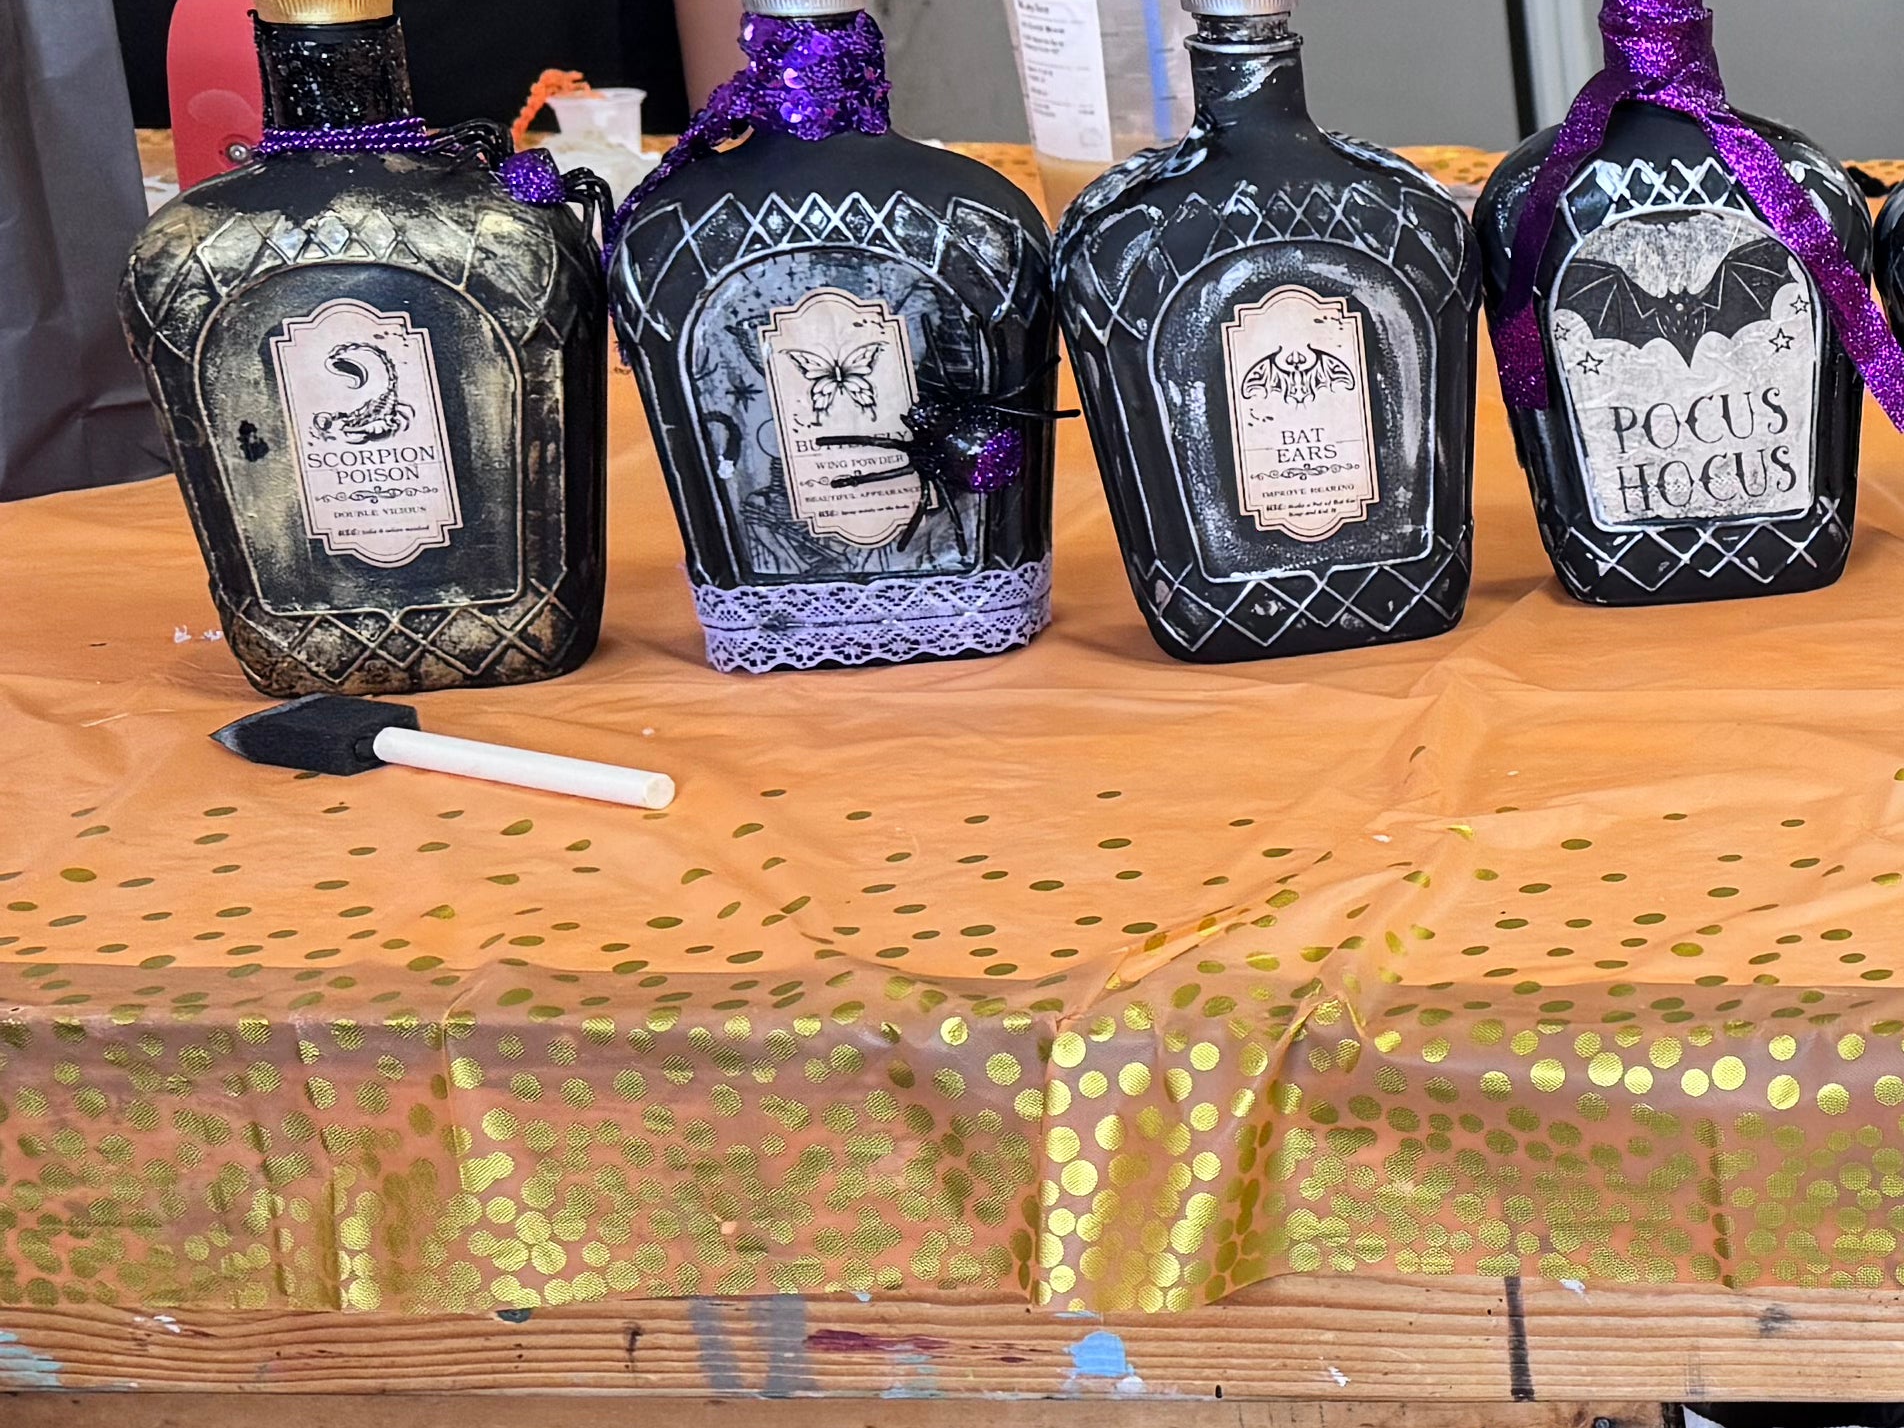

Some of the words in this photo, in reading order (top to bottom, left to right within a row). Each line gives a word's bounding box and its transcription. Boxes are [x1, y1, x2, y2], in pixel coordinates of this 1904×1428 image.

[1608, 387, 1789, 454] POCUS
[1281, 427, 1326, 445] BAT
[307, 445, 436, 469] SCORPION
[815, 457, 848, 470] WING
[851, 454, 905, 469] POWDER
[1277, 444, 1338, 464] EARS
[337, 465, 420, 485] POISON
[1616, 445, 1798, 514] HOCUS
